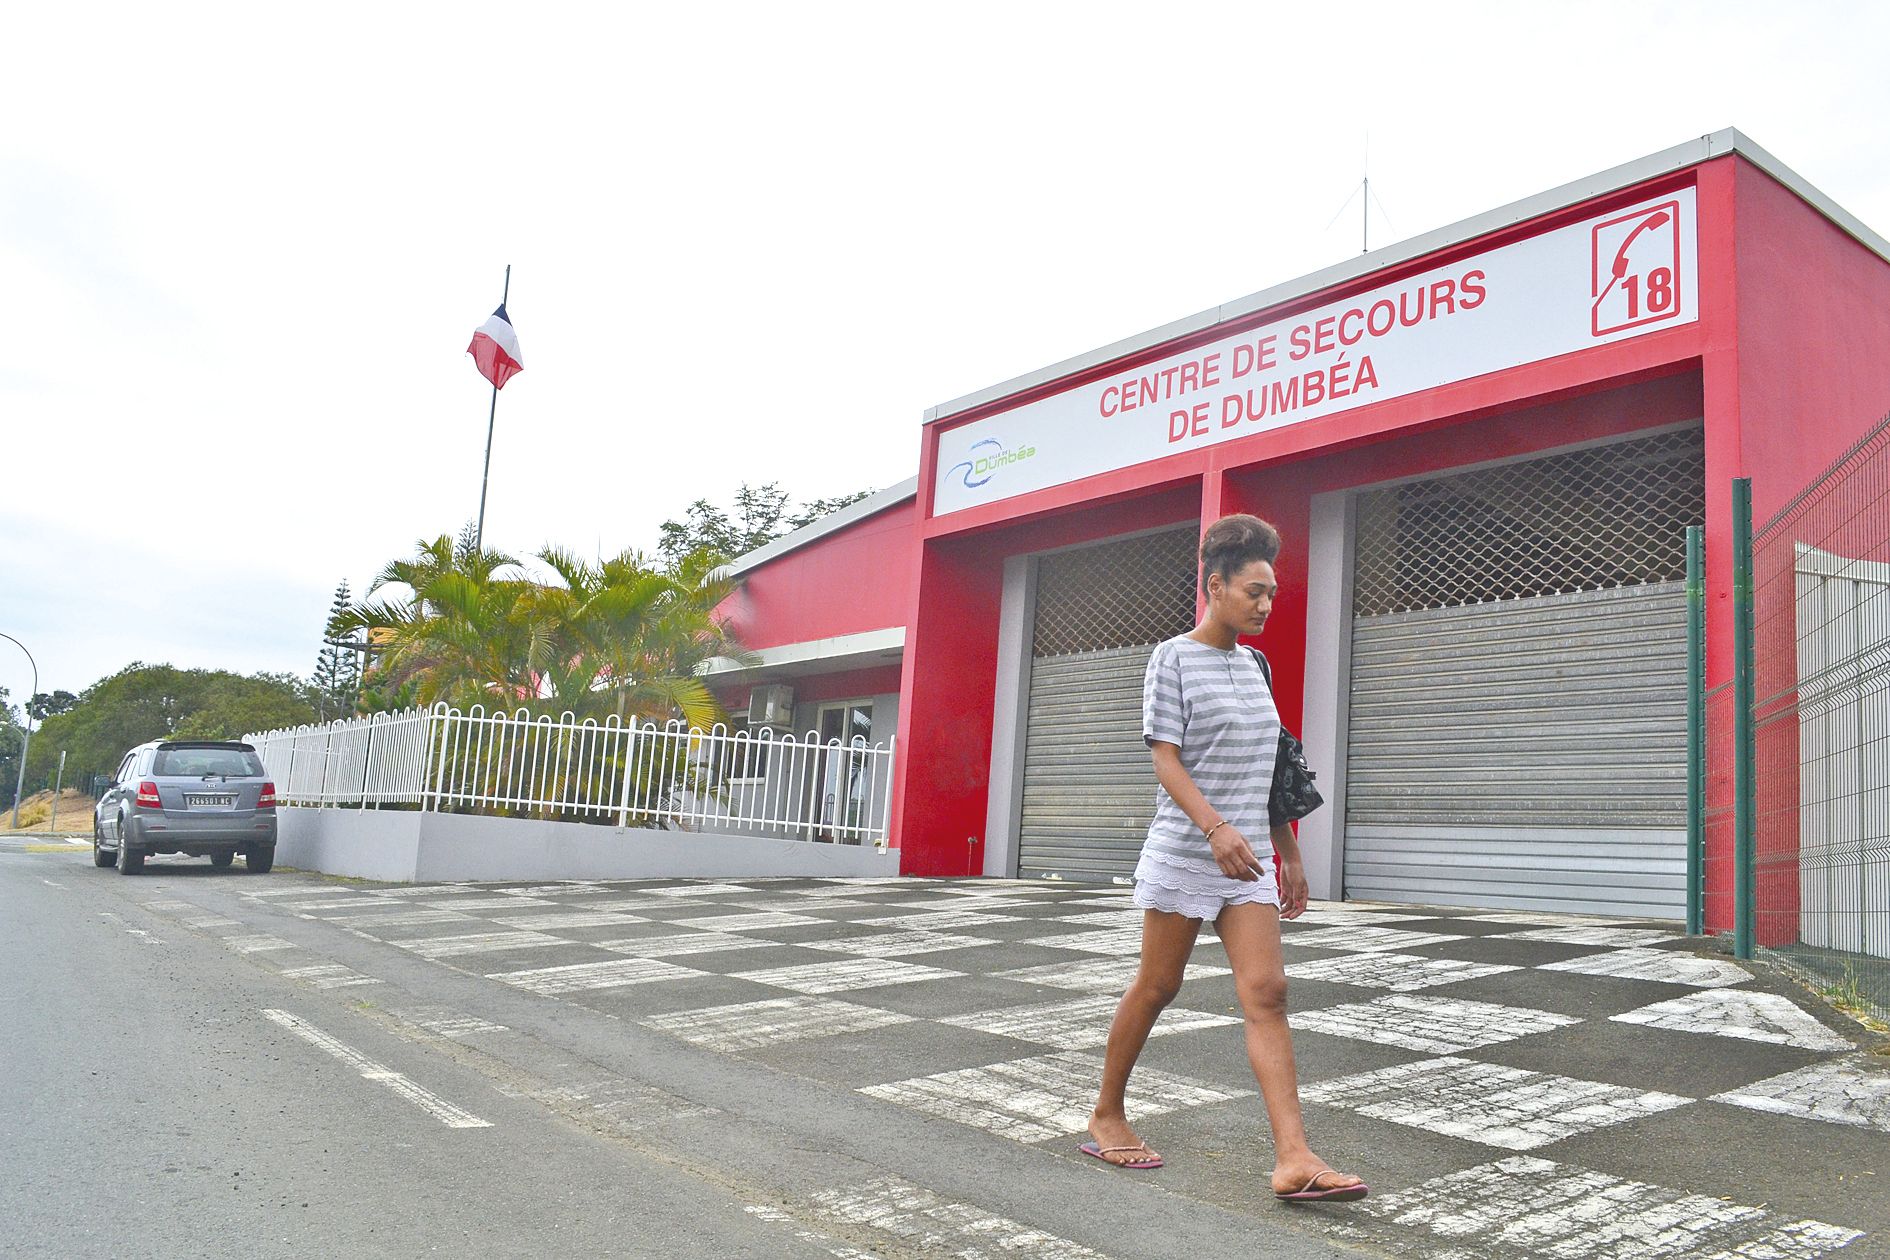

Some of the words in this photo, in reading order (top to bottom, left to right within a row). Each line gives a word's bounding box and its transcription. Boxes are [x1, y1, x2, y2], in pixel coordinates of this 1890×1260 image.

[1621, 267, 1672, 319] 18
[1101, 354, 1219, 417] CENTRE
[1233, 336, 1276, 378] DE
[1290, 270, 1486, 360] SECOURS
[1169, 403, 1209, 443] DE
[1222, 352, 1378, 428] DUMBÉA
[975, 445, 1036, 475] Dumbéa
